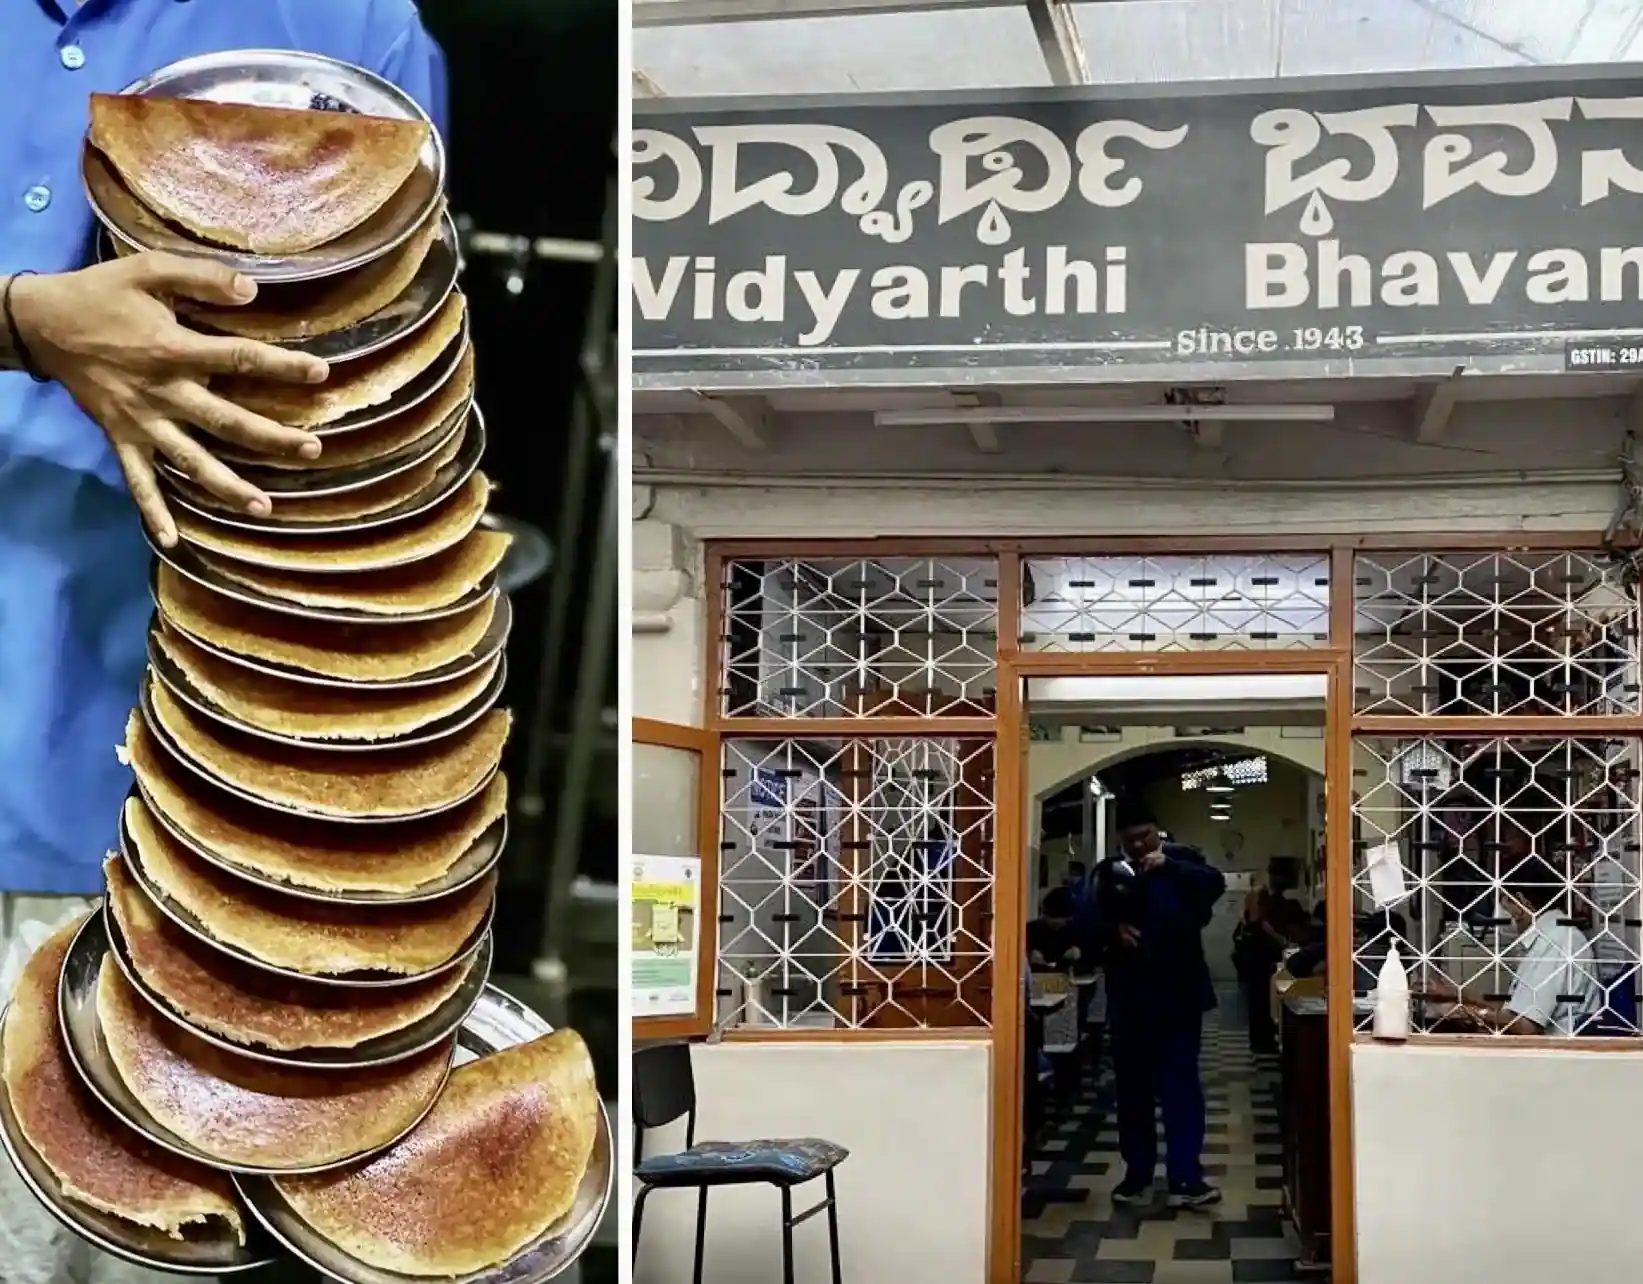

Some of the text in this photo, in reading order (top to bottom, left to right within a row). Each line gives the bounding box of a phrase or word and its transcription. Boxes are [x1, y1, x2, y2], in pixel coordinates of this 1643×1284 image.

[632, 238, 1643, 346] Vidyarthi Bhavan
[1177, 325, 1365, 355] since 1943
[1570, 347, 1617, 365] GSTIN:
